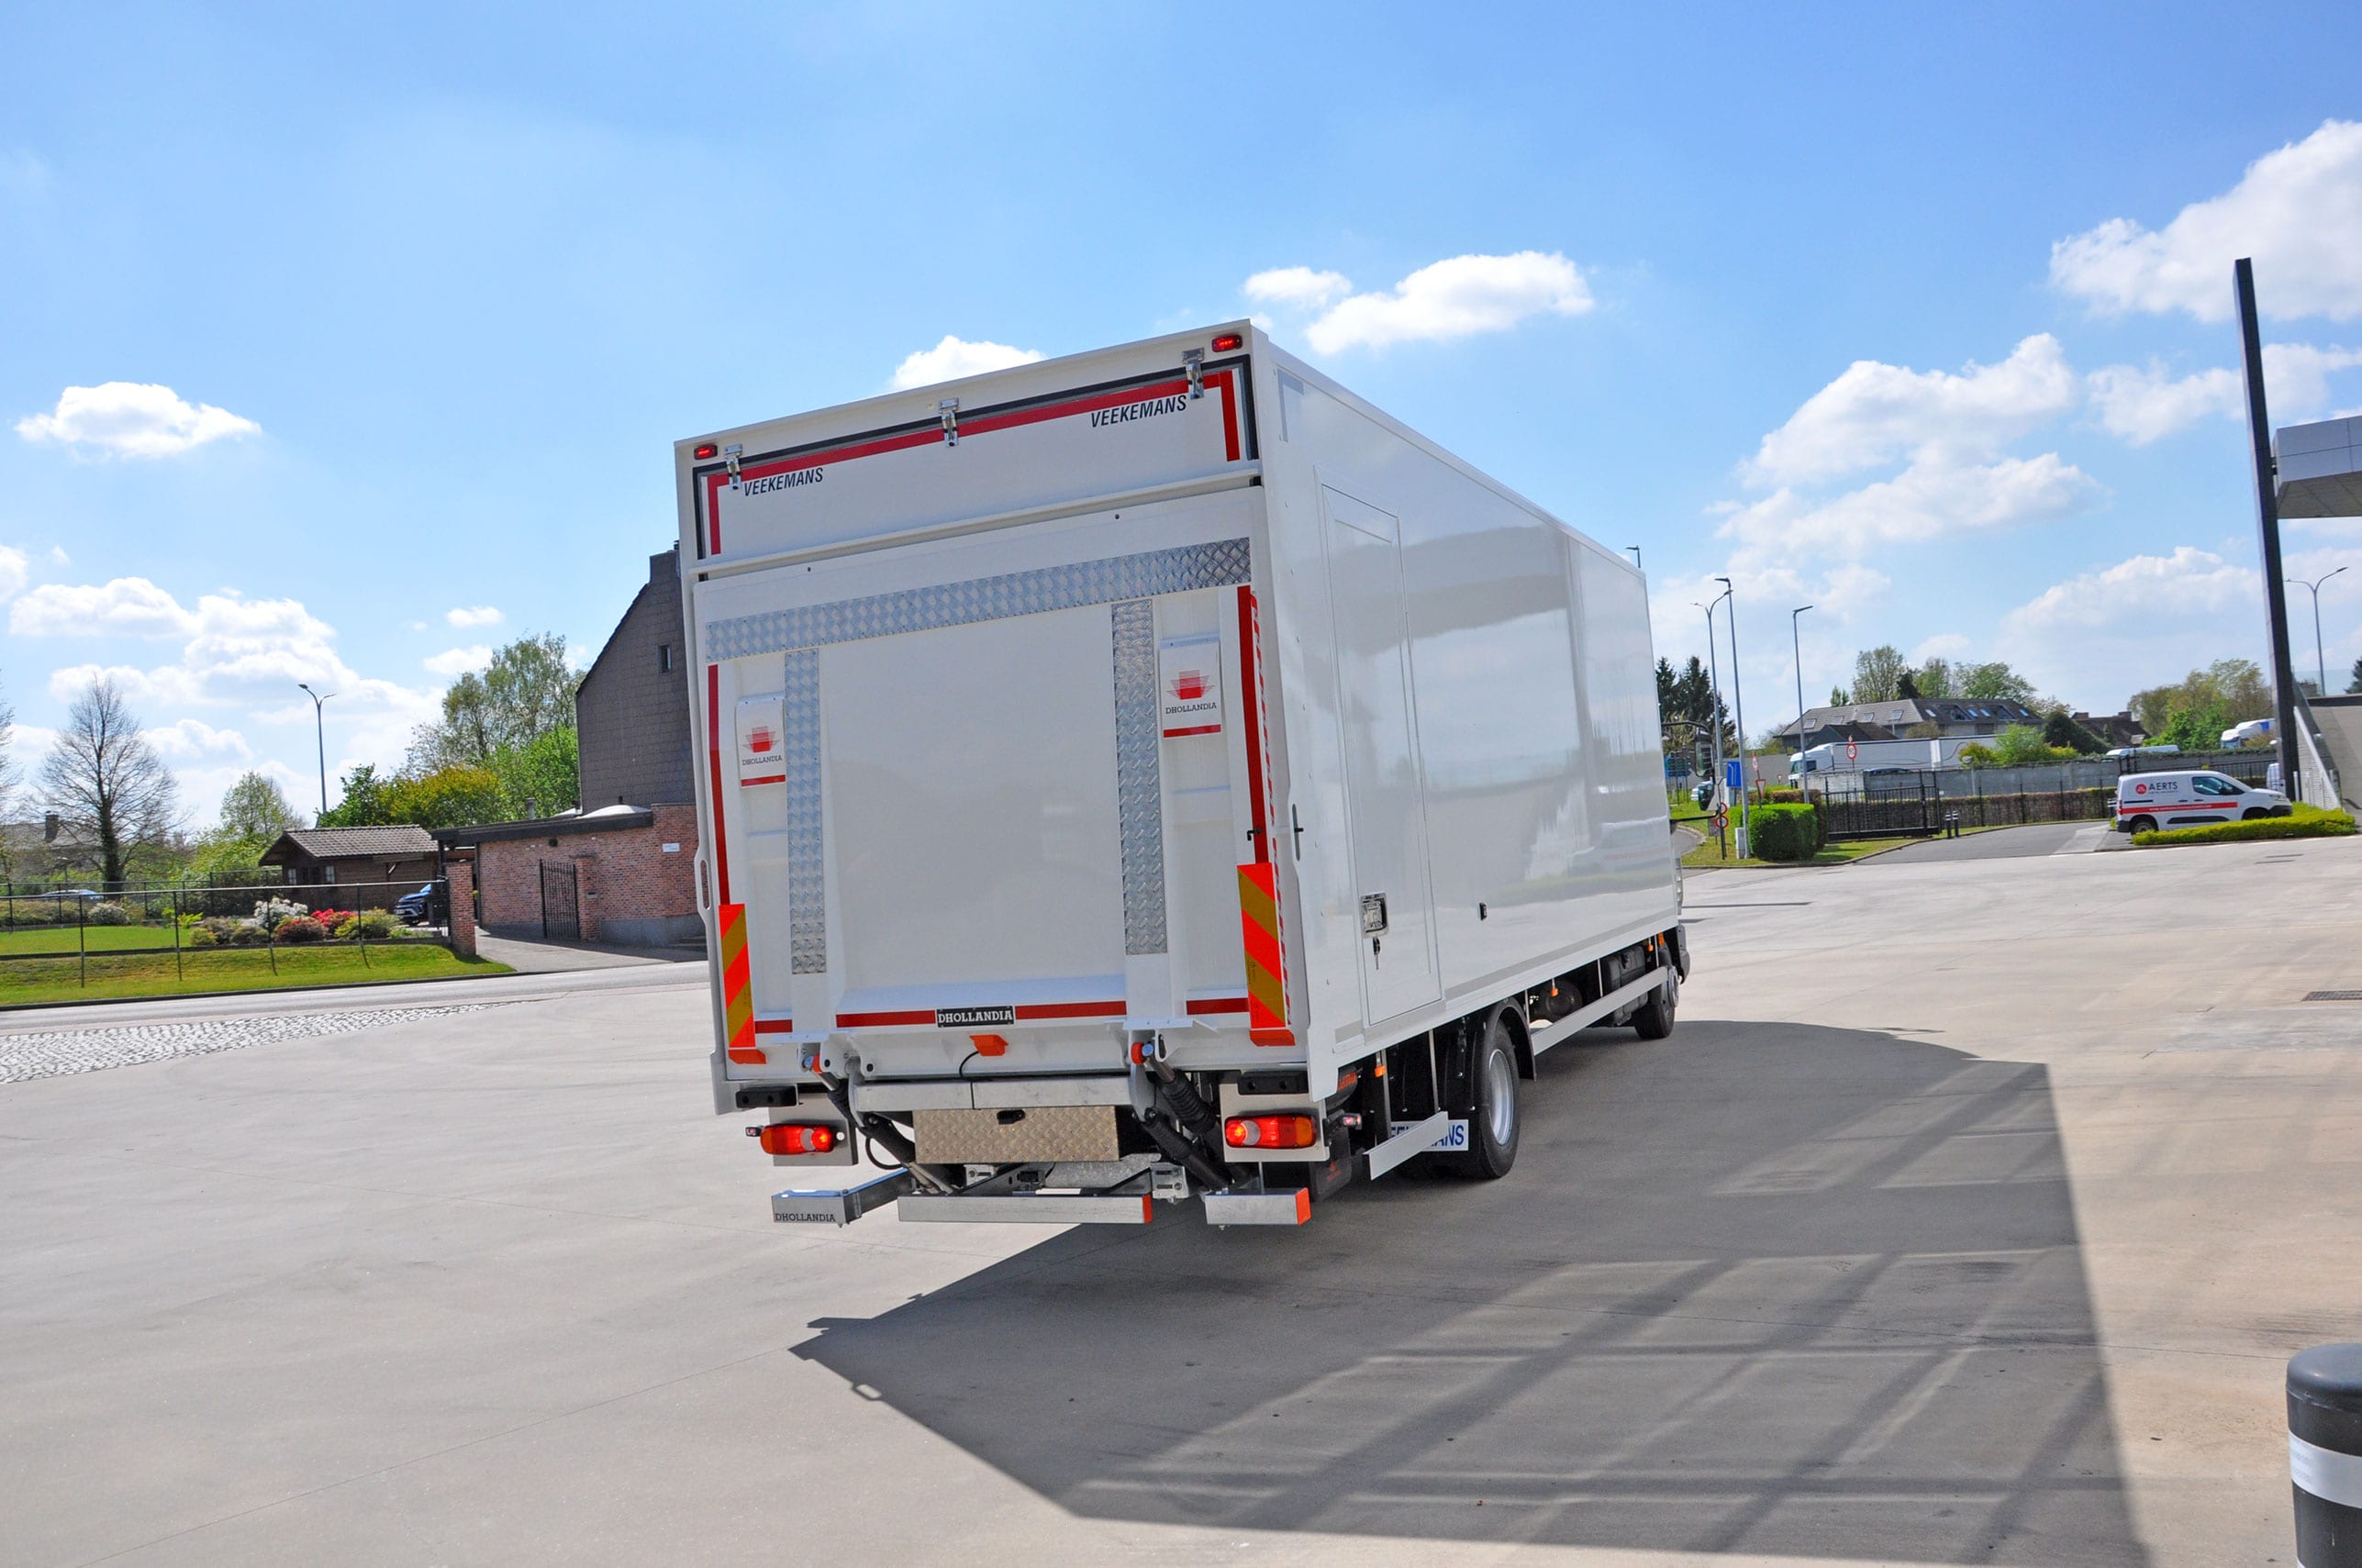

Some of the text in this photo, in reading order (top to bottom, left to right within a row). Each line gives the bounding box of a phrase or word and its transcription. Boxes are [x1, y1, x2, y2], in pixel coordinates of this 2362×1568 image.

[1091, 395, 1187, 428] VEEKEMANS
[744, 467, 823, 496] VEEKEMANS
[1165, 702, 1217, 714] DHOLLANDIA
[741, 755, 782, 765] DHOLLANDIA
[2148, 782, 2178, 791] AERTS
[938, 1010, 1013, 1023] DHOLLANDIA
[774, 1213, 836, 1222] DHOLLANDIA
